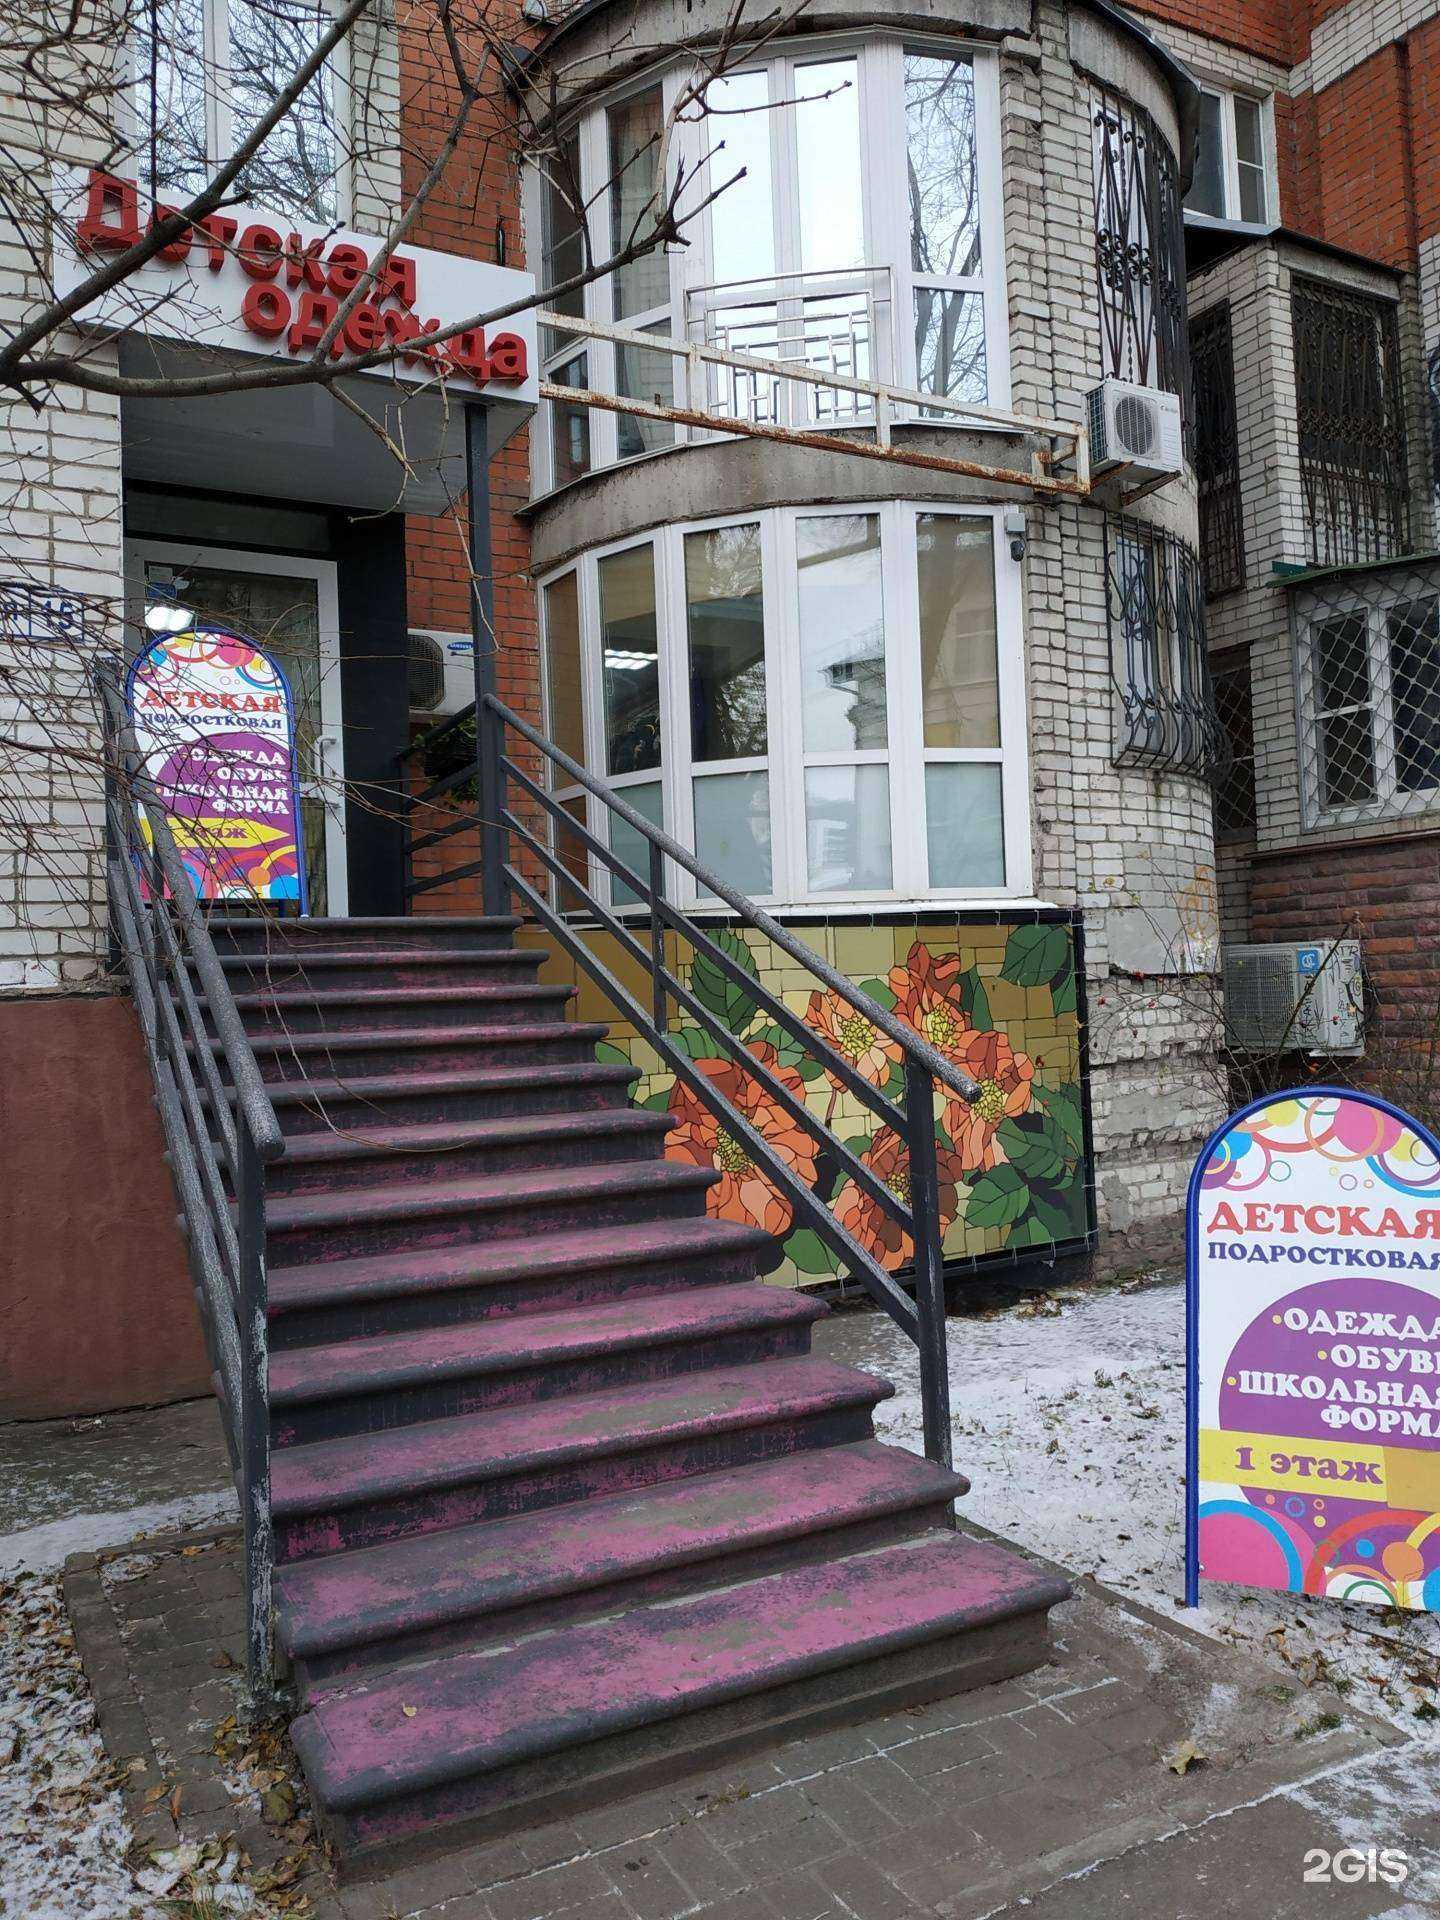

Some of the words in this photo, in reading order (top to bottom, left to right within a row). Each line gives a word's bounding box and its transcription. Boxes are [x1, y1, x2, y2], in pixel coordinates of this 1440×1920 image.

[241, 281, 529, 389] одежда
[140, 690, 281, 713] ДЕТСКАЯ
[142, 713, 282, 729] ПОДРОСТКОВАЯ
[212, 799, 290, 814] ФОРМА
[185, 823, 248, 839] аж
[1207, 1201, 1440, 1240] ДЕТСКАЯ
[1207, 1242, 1440, 1271] ПОДРОСТКОВАЯ
[1330, 1343, 1440, 1375] ОБУВ
[1238, 1370, 1440, 1410] ШКОЛЬНА
[1234, 1447, 1256, 1471] 1
[1270, 1452, 1384, 1485] этаж
